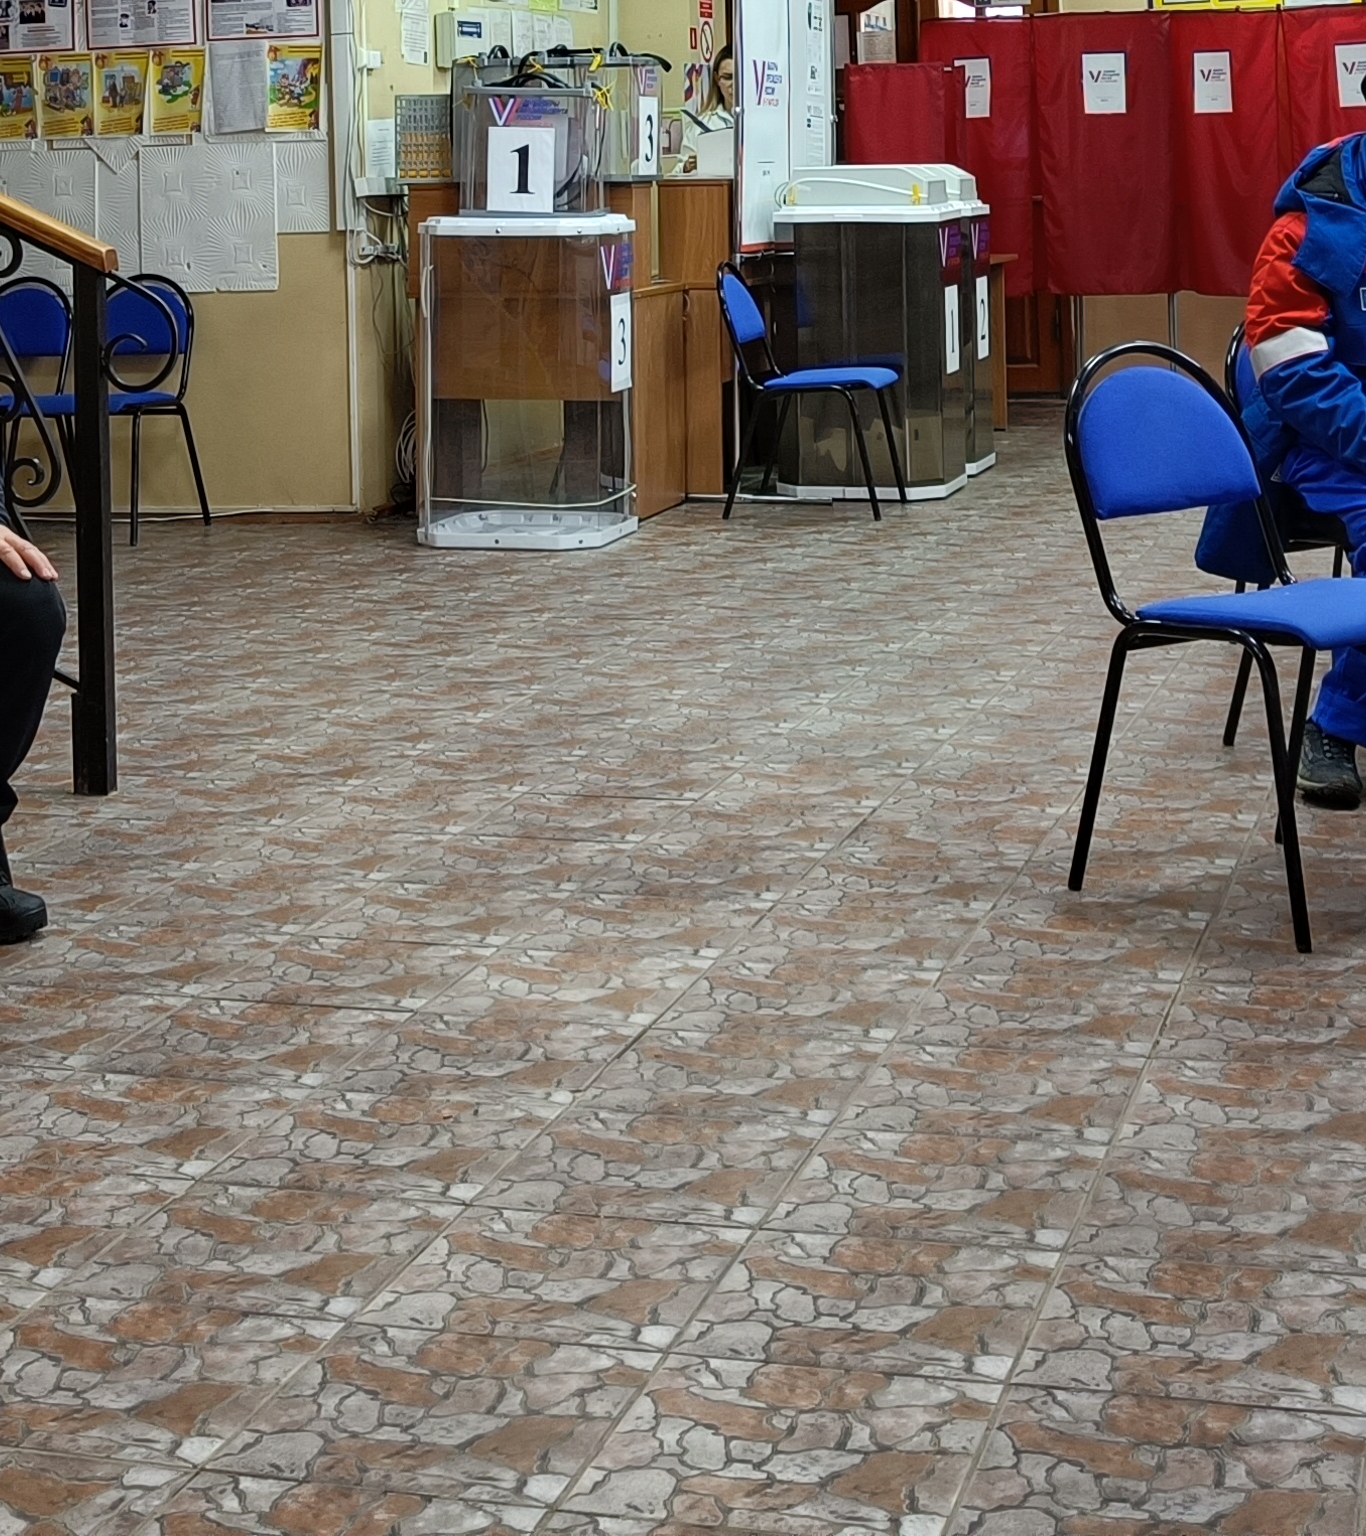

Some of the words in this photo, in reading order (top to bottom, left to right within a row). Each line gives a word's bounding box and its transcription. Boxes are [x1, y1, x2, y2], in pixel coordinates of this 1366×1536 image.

[645, 115, 653, 162] 3
[510, 144, 535, 194] 1
[618, 318, 626, 365] 3
[980, 298, 986, 340] 2
